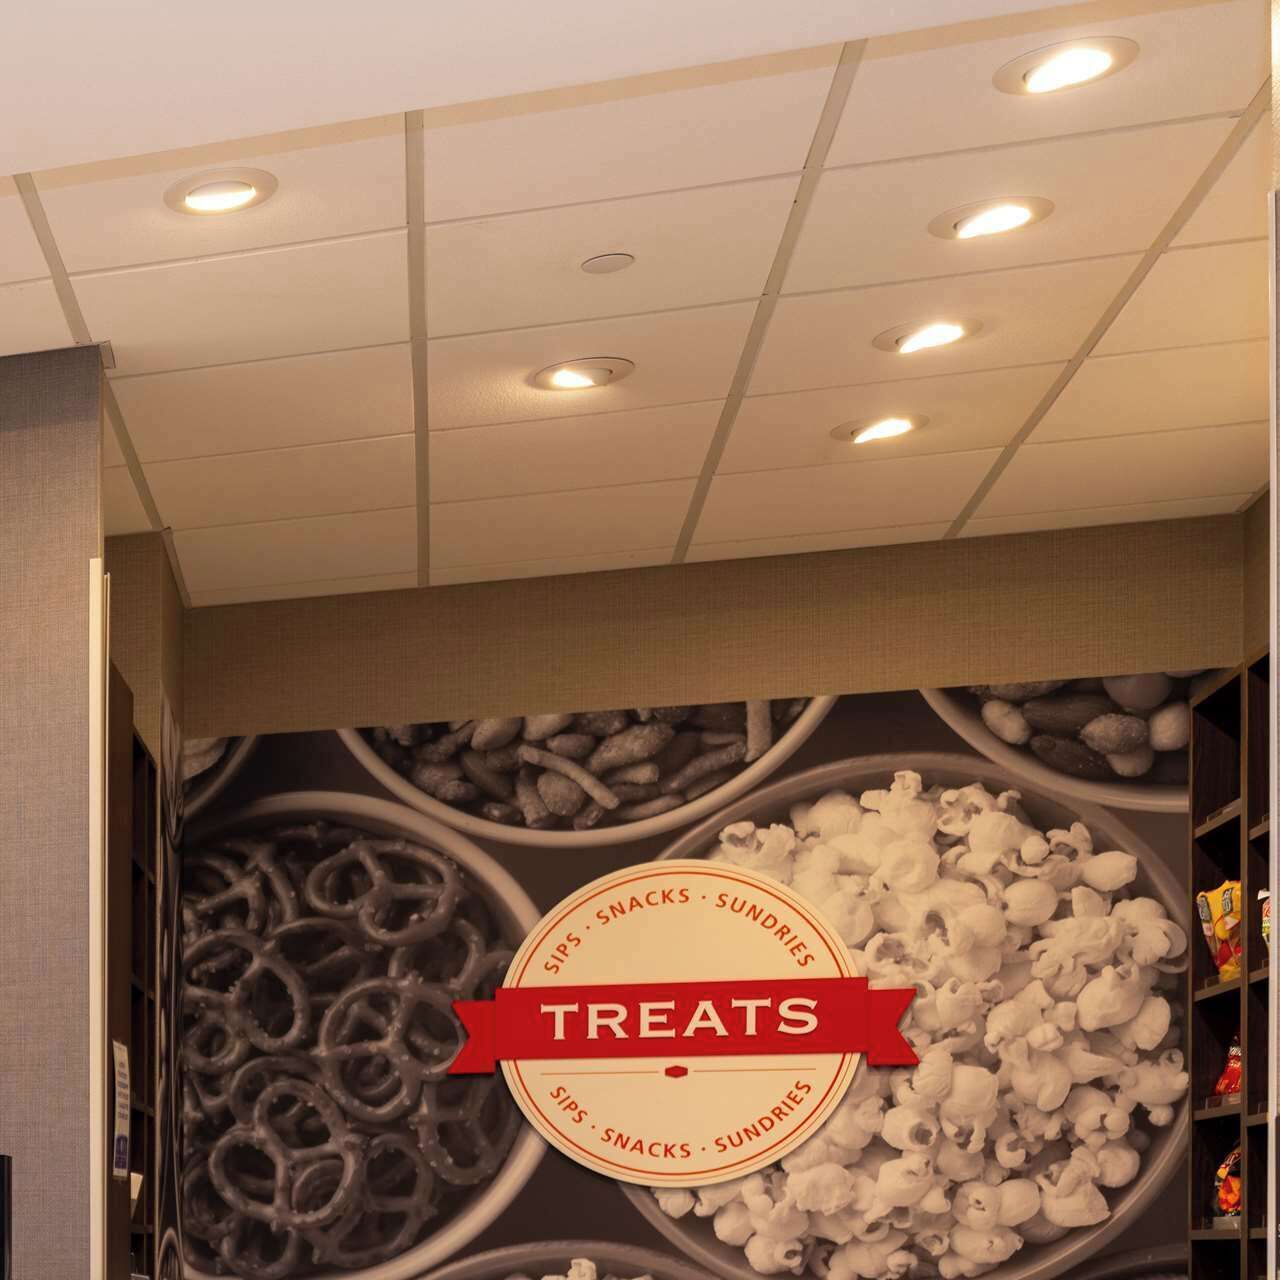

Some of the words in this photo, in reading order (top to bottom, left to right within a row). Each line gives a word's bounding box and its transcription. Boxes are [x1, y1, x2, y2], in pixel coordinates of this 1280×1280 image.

[544, 932, 583, 975] SIPS
[596, 888, 690, 926] SNACKS
[716, 893, 815, 969] SUNDRIES
[540, 997, 819, 1041] TREATS
[550, 1086, 588, 1124] SIPS
[601, 1128, 692, 1159] SNACKS
[714, 1080, 812, 1153] SUNDRIES
